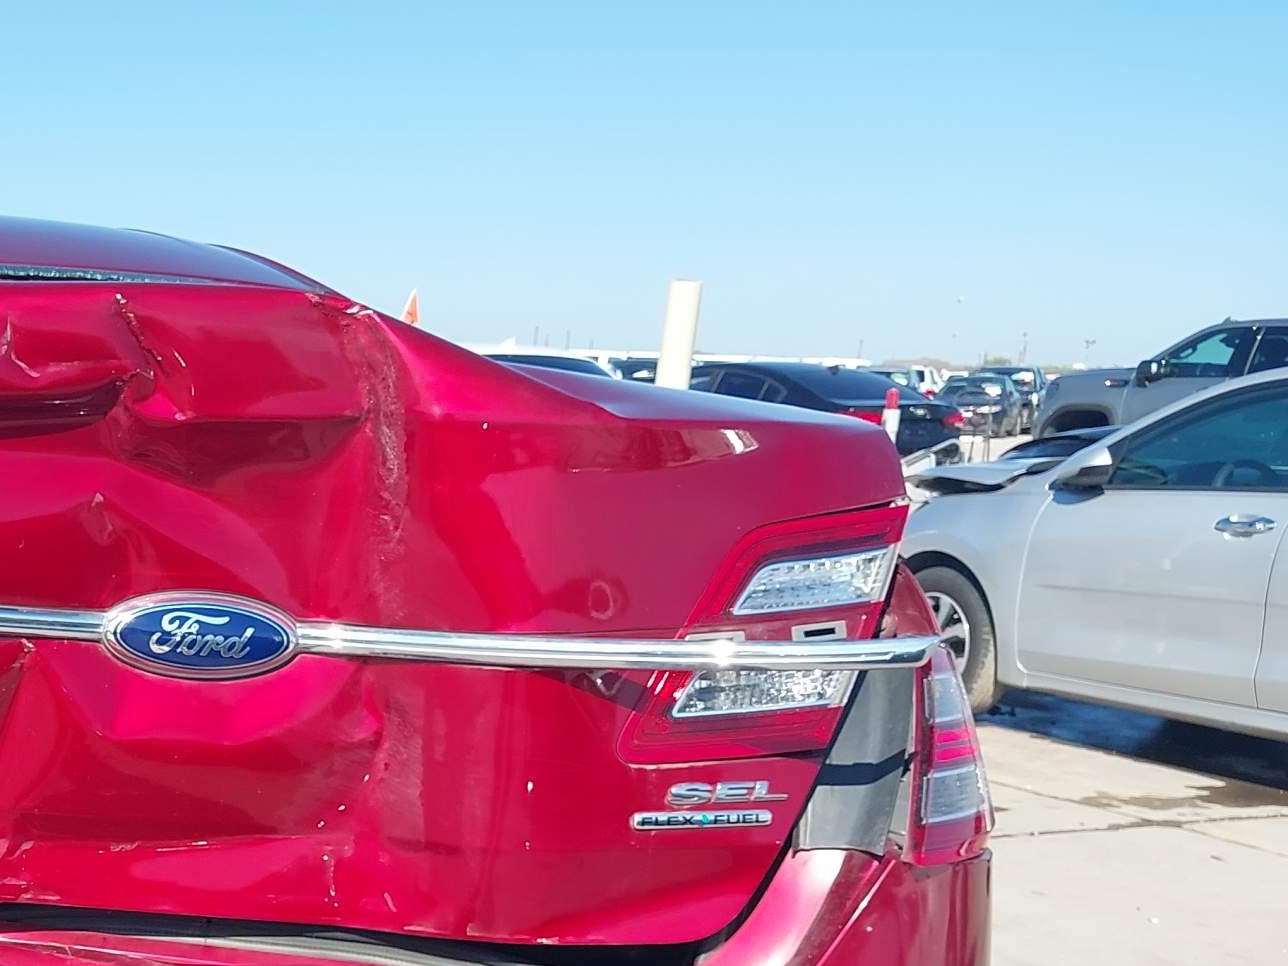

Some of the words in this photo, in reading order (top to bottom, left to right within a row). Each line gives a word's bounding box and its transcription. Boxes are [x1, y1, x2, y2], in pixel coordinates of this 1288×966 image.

[149, 611, 255, 659] Ford
[666, 780, 789, 806] SEL
[638, 815, 695, 827] FLEX
[712, 813, 769, 825] FUEL
